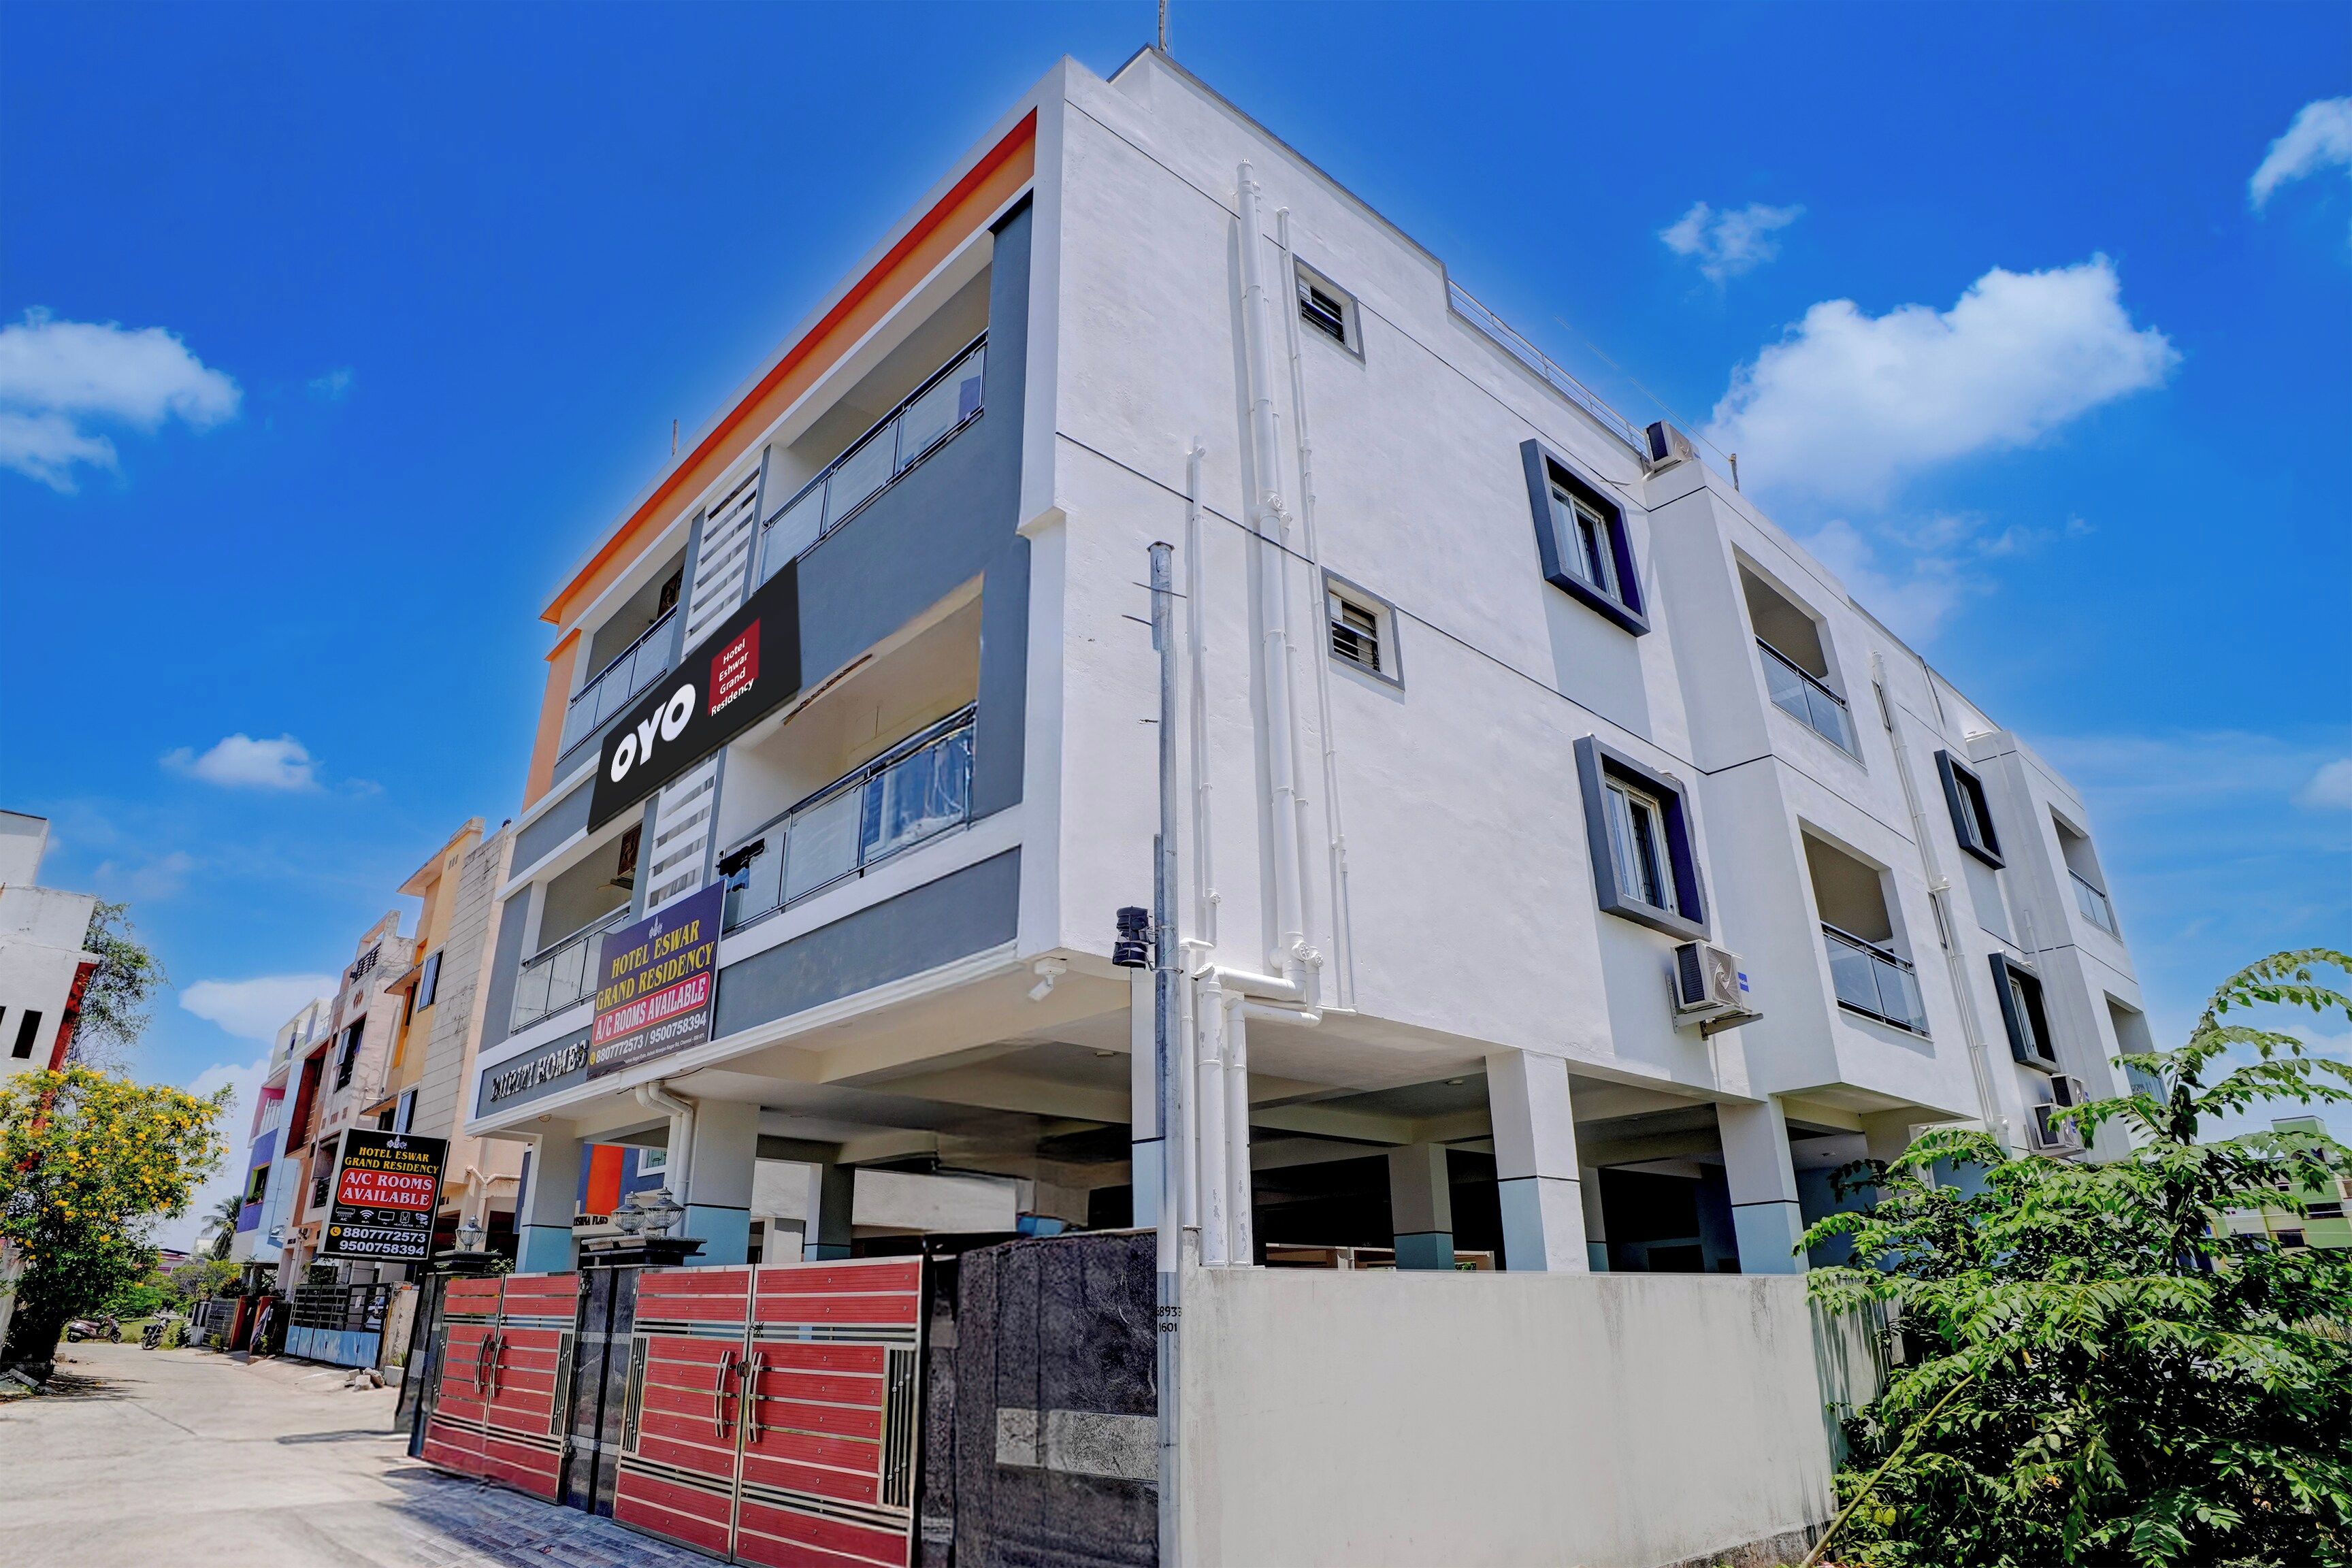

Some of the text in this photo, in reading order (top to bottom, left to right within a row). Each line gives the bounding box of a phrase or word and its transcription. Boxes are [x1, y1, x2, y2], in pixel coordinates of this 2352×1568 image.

[723, 638, 745, 665] Hotel
[719, 652, 749, 682] Eshwar
[719, 670, 746, 695] Grand
[711, 677, 754, 717] Residency
[610, 683, 696, 783] OYO
[610, 919, 700, 979] HOTEL ESWAR
[595, 941, 715, 1011] GRAND RESIDENCY
[595, 977, 706, 1041] A/C ROOMS AVAILABLE
[595, 1033, 644, 1064] 8807772573
[649, 1011, 707, 1045] 9500758394
[534, 1039, 589, 1084] HOMES
[344, 1156, 439, 1175] GRAND RESIDENCY
[359, 1147, 429, 1162] HOTEL ESWAR
[345, 1172, 432, 1190] A/C ROOMS
[342, 1188, 430, 1206] AVAILABLE
[340, 1240, 425, 1256] 9500758394
[343, 1227, 426, 1243] 8807772573
[1158, 1322, 1177, 1333] 1601
